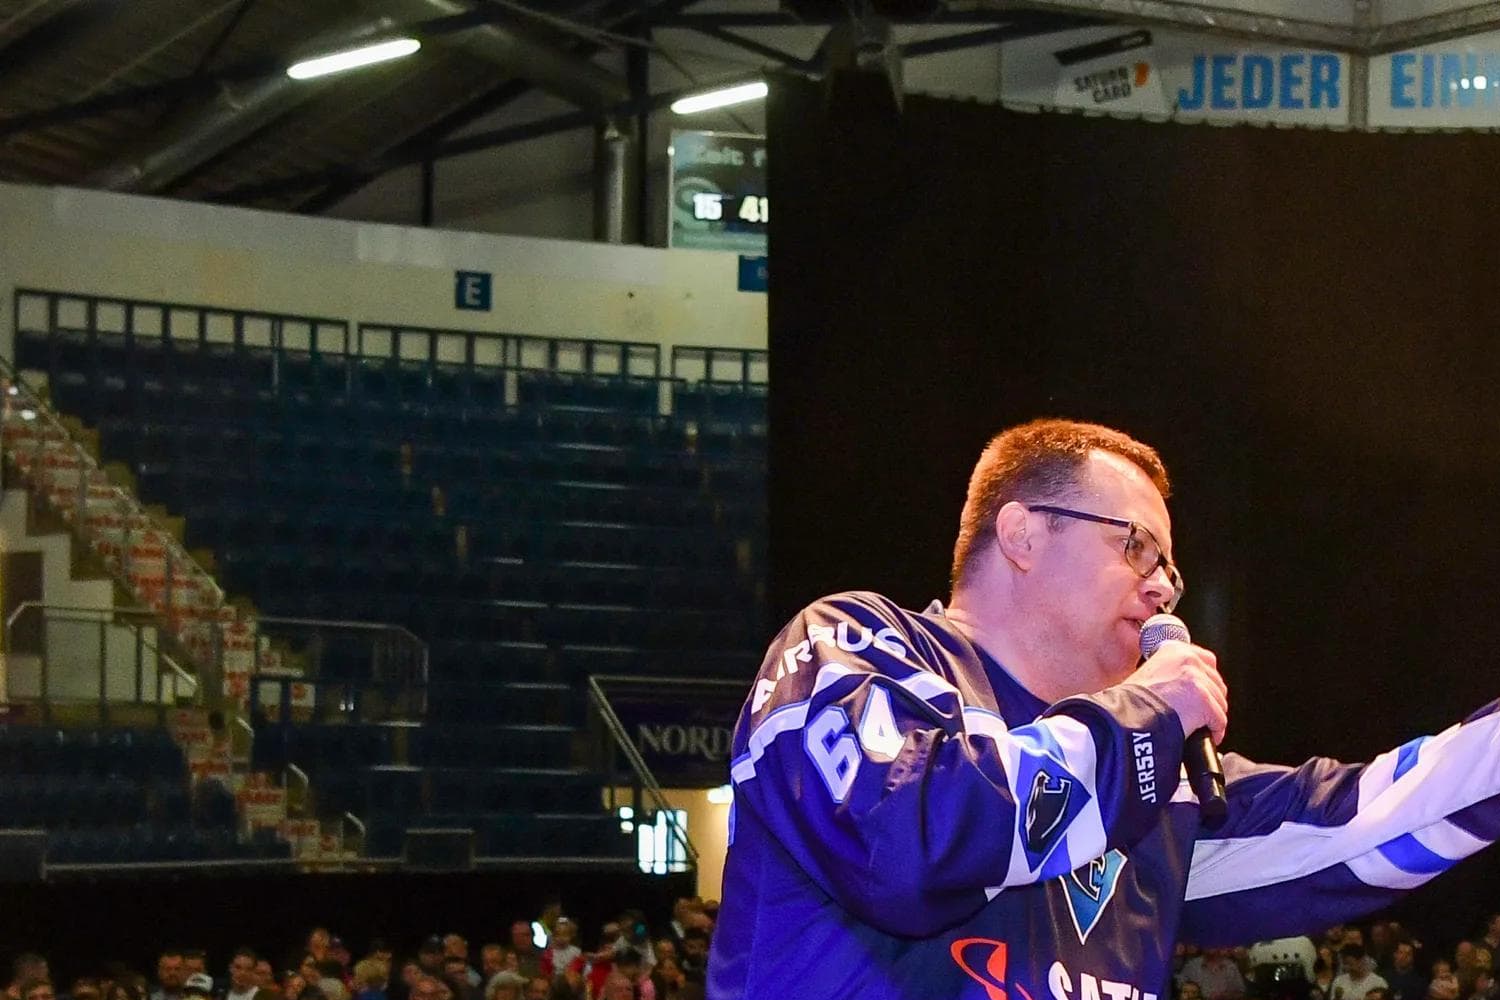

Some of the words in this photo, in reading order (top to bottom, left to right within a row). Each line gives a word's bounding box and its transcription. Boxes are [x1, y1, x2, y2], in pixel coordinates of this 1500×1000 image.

[1177, 53, 1341, 111] JEDER
[465, 278, 482, 305] E
[1131, 731, 1157, 804] JER53Y
